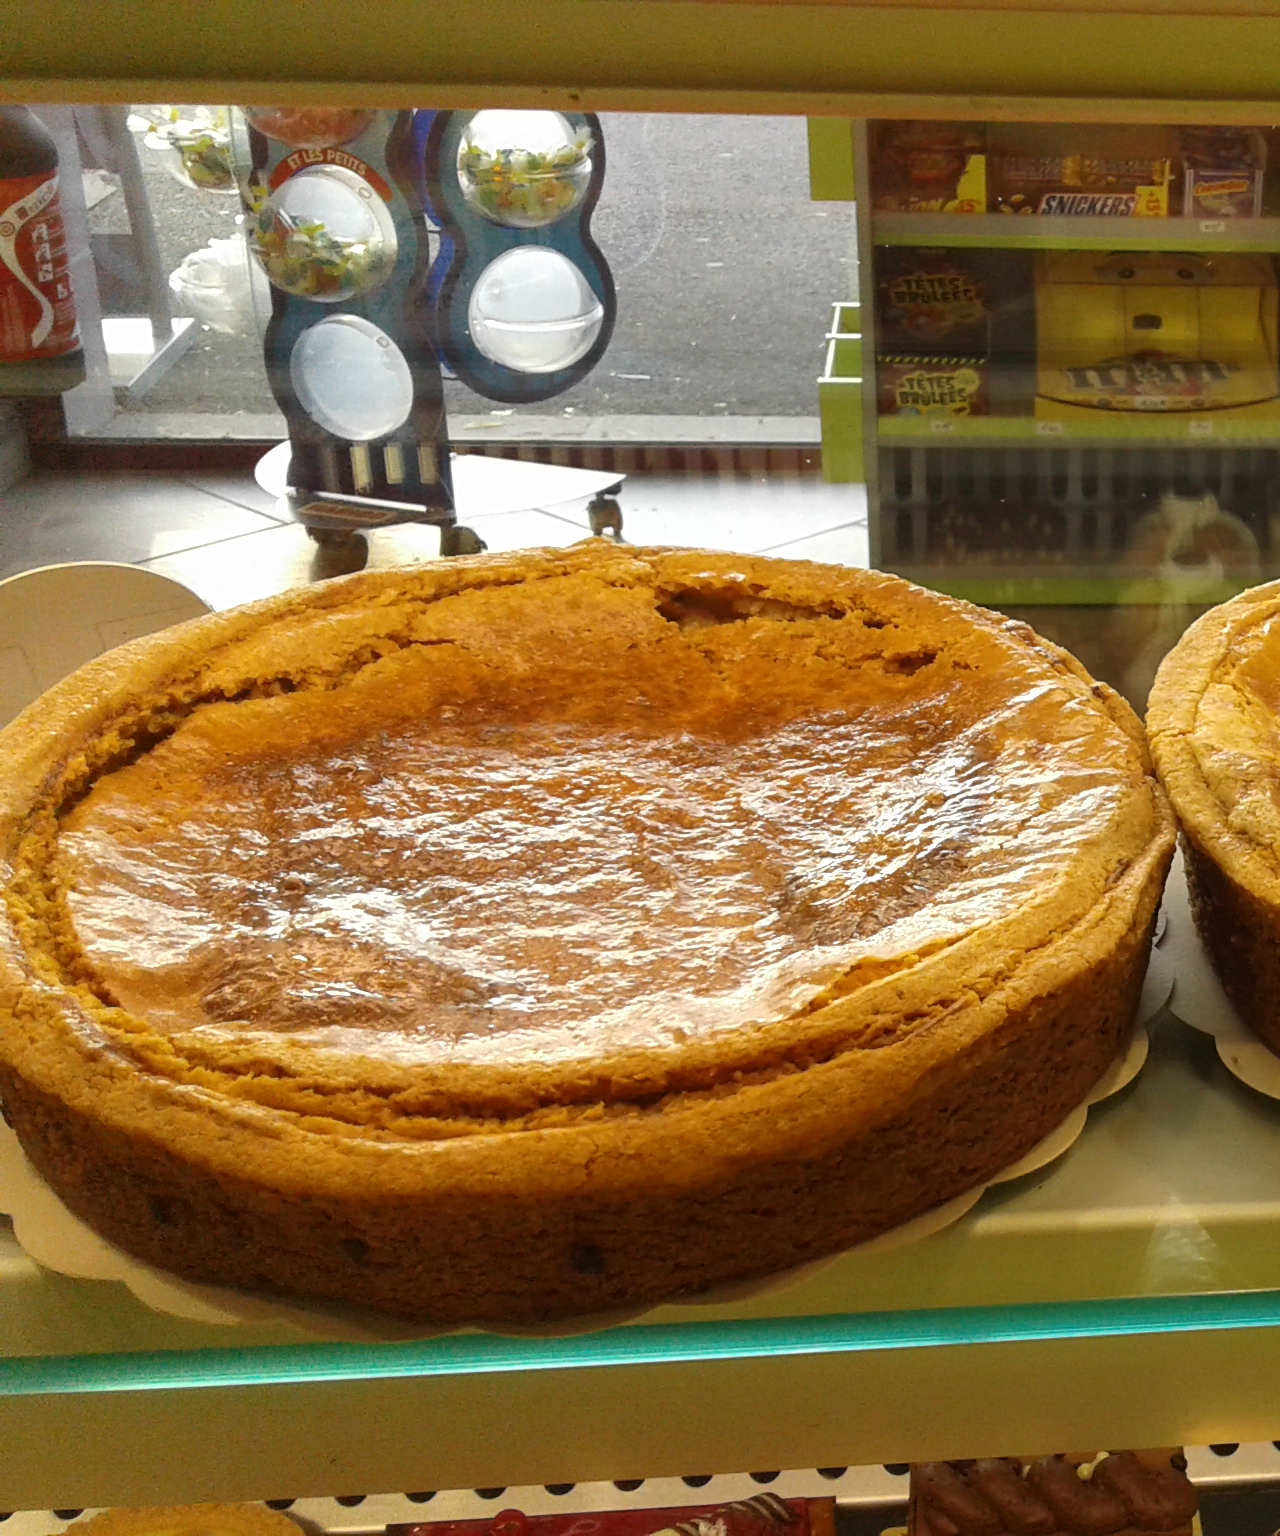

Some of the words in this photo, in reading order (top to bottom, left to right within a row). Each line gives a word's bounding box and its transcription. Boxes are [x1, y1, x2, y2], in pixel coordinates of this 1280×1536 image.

[287, 156, 301, 169] ET
[302, 150, 323, 162] LES
[327, 150, 368, 175] PETITS
[1040, 194, 1135, 215] SNICKERS
